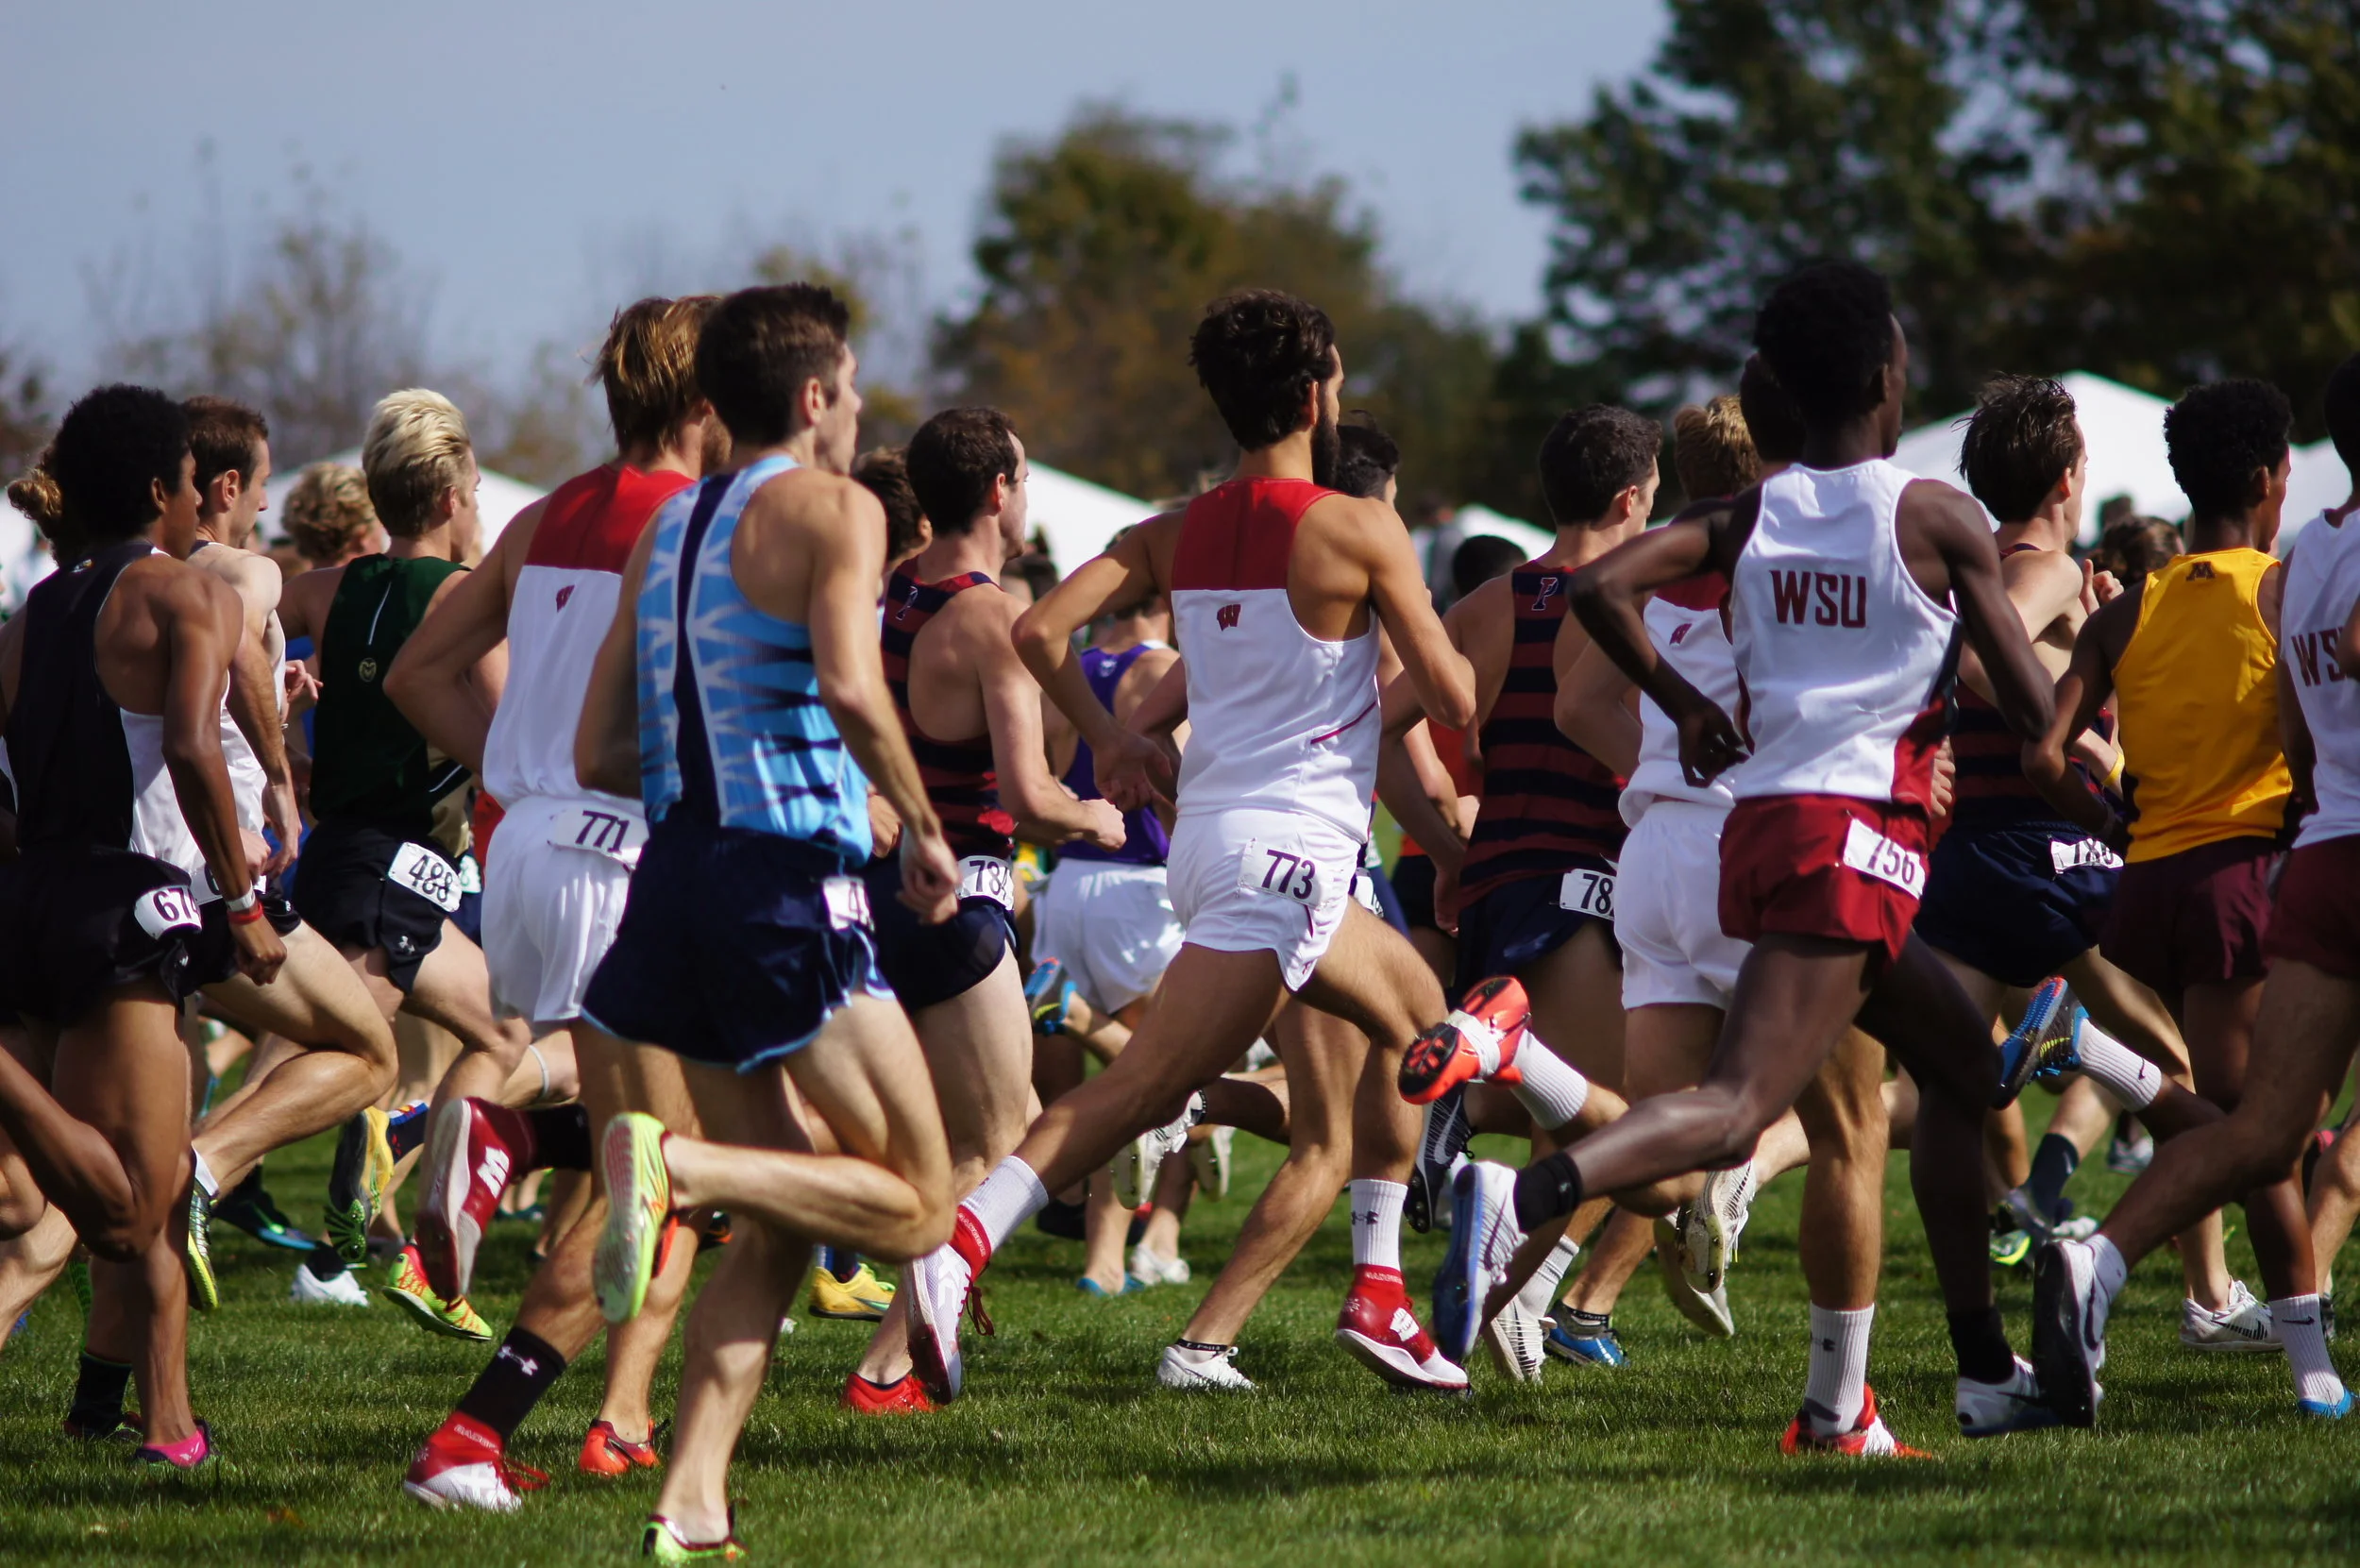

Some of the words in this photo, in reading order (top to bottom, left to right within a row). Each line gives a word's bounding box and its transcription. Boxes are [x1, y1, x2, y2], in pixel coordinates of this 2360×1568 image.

[2185, 561, 2216, 582] M
[1531, 577, 1559, 611] P
[1768, 569, 1867, 629] WSU
[1216, 603, 1241, 632] W
[1668, 623, 1693, 647] W
[2290, 626, 2345, 688] WS
[574, 809, 631, 855] 771
[408, 853, 453, 903] 488
[1261, 849, 1316, 900] 773
[1580, 872, 1614, 915] 78
